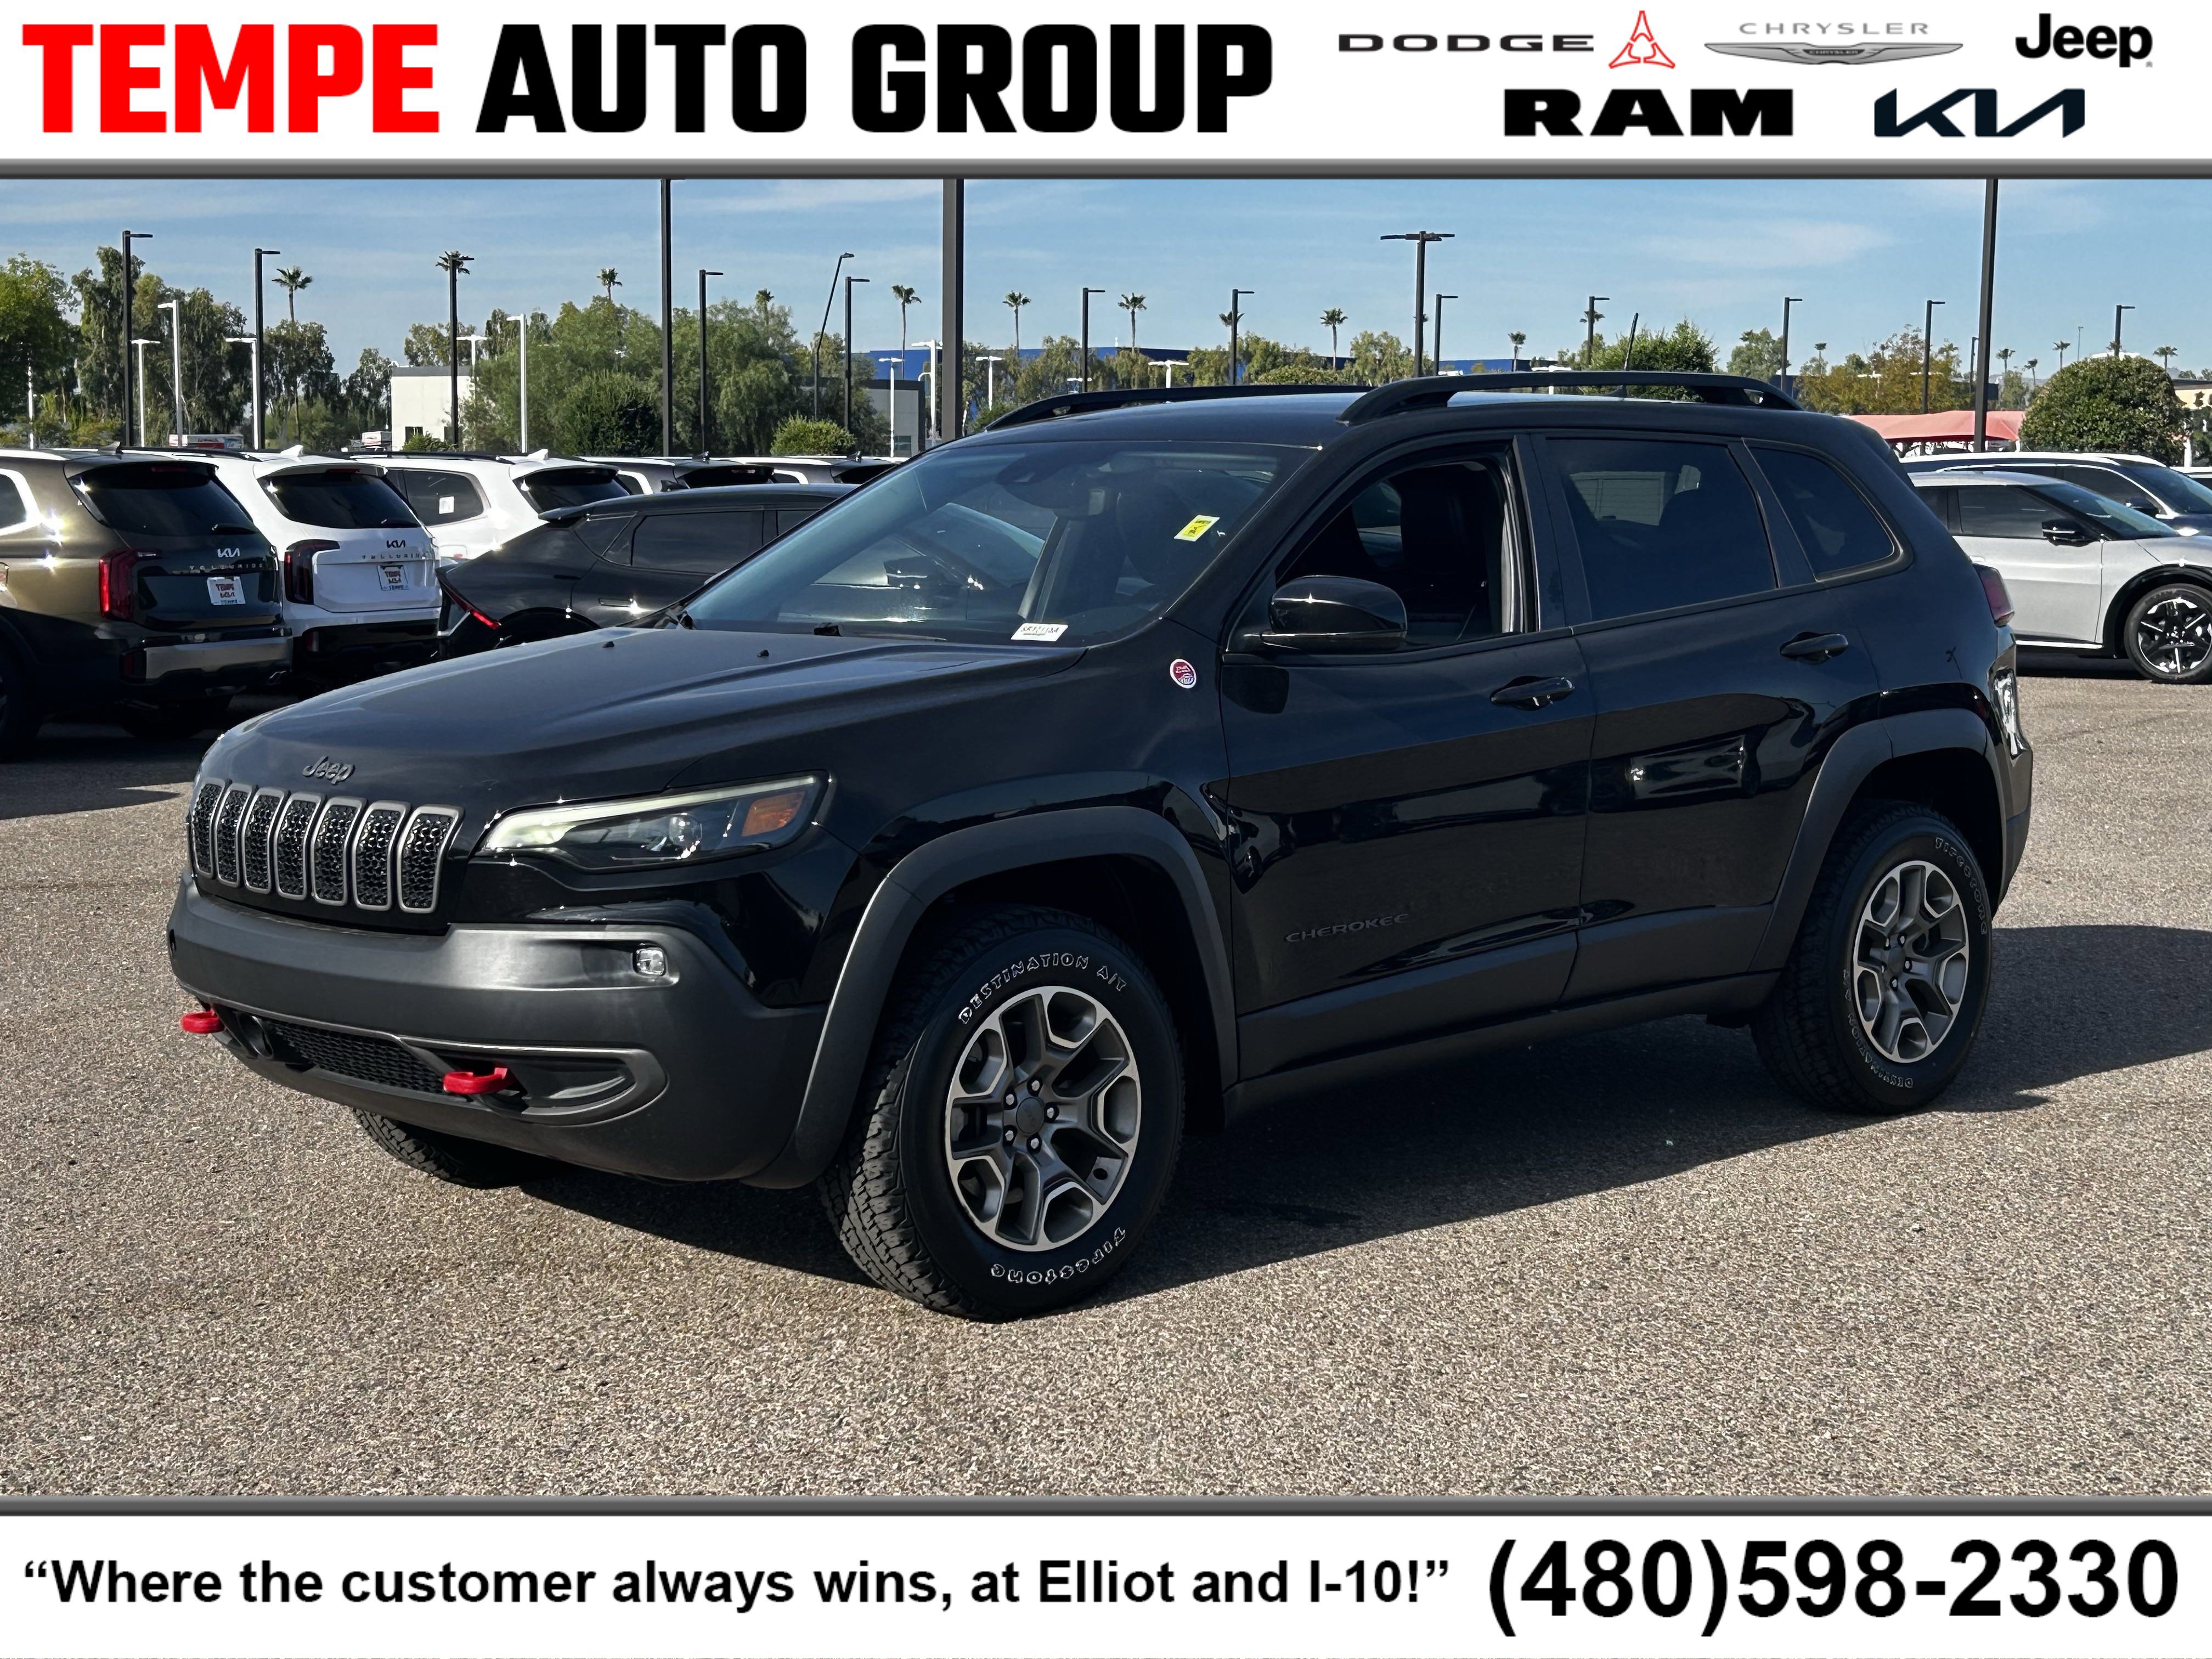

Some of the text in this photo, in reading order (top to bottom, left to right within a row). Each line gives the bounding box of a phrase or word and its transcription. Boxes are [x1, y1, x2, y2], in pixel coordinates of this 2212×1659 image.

[302, 756, 356, 786] Jeep
[1284, 913, 1408, 943] CHEROKEE
[957, 952, 1089, 1025] DESTINATION
